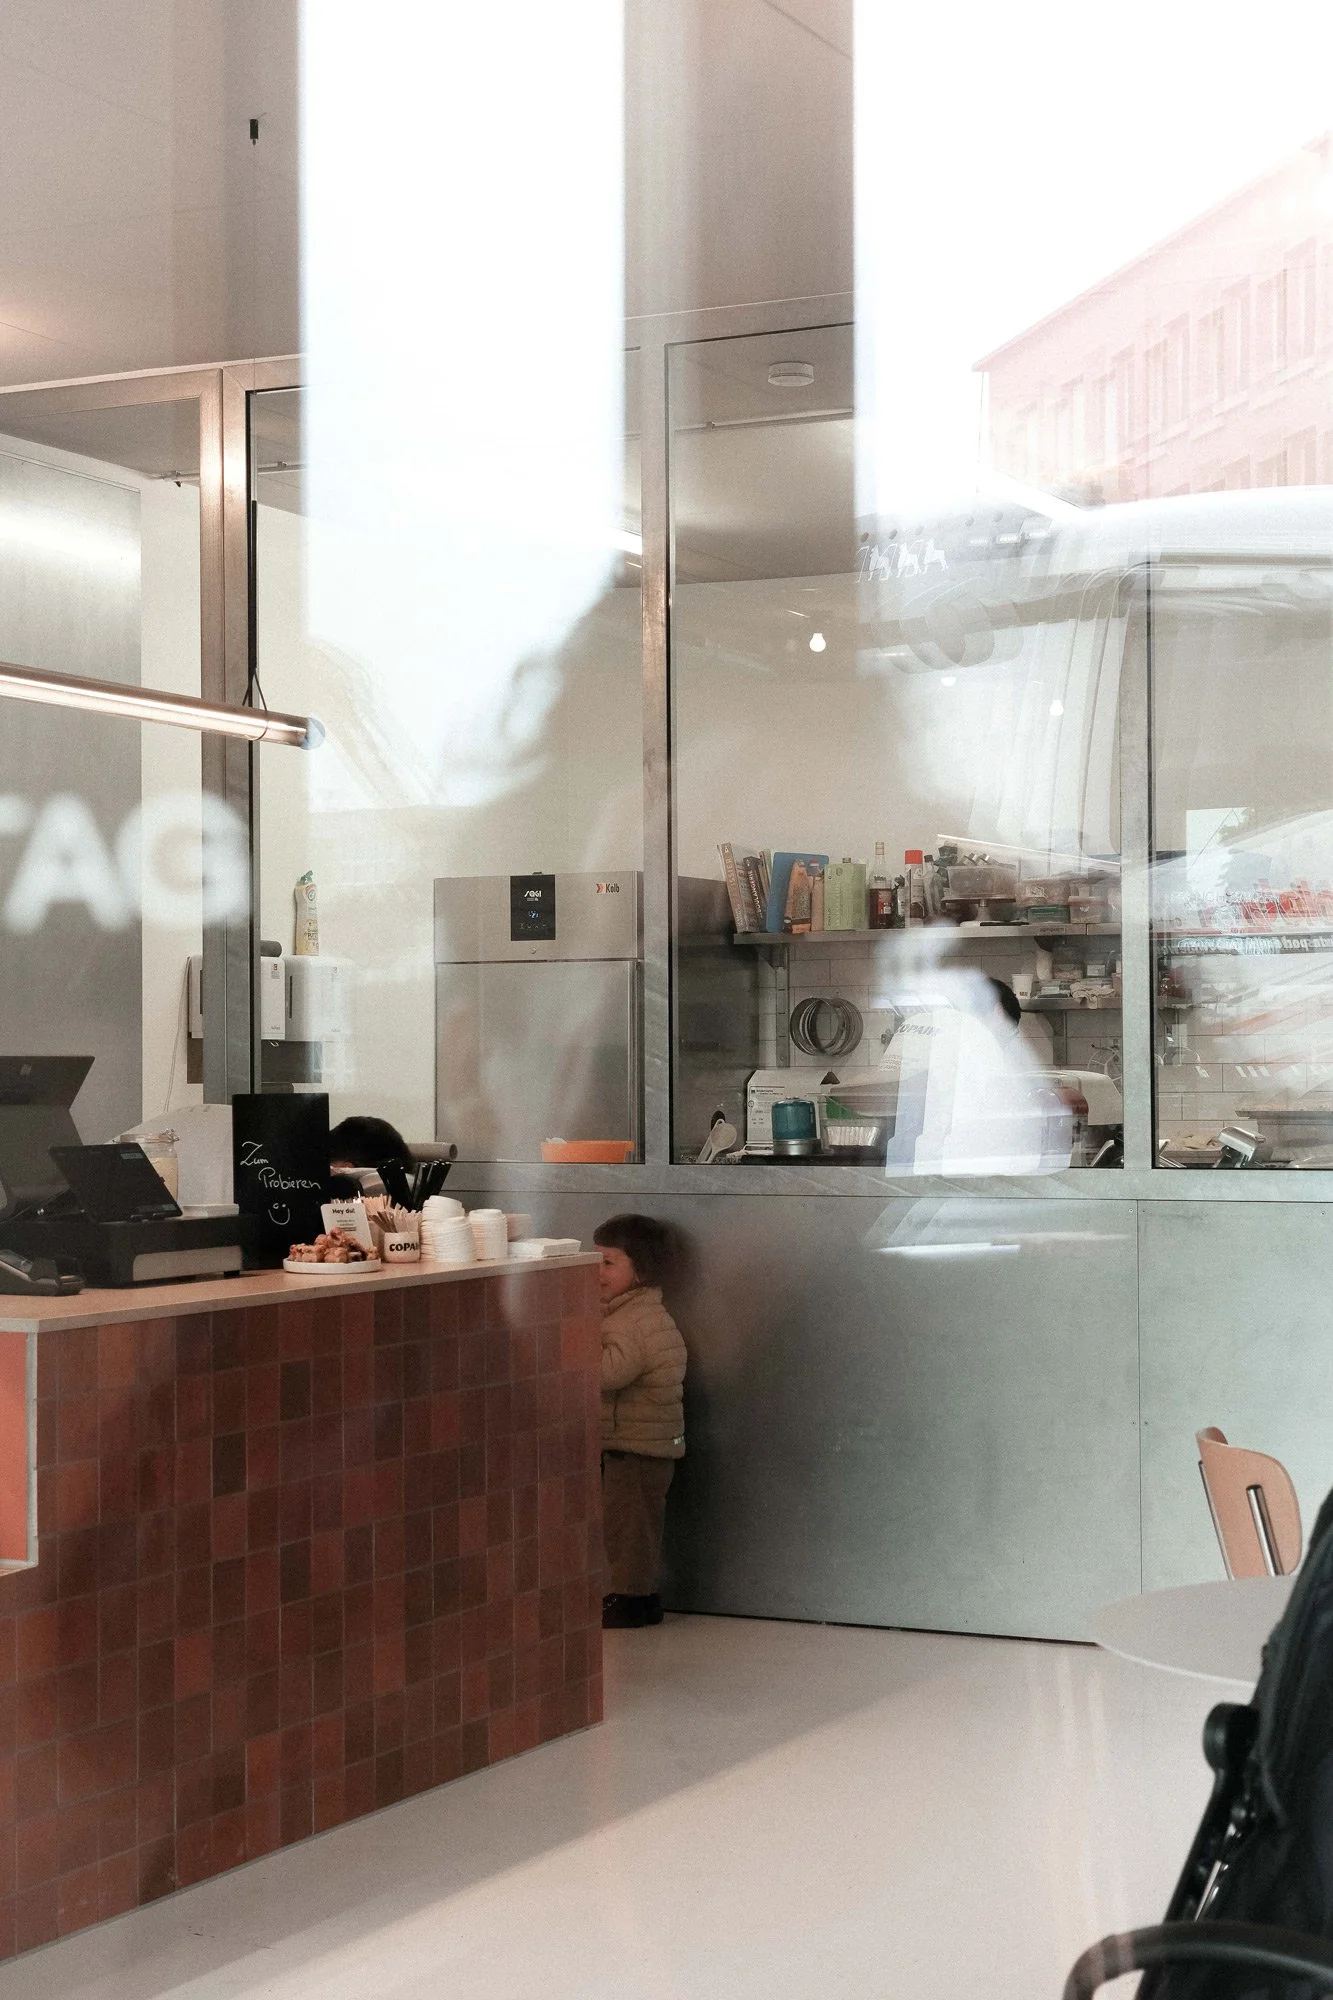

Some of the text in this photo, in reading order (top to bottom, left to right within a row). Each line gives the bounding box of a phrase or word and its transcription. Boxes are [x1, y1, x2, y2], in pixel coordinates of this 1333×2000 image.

[605, 883, 620, 893] Kolb
[748, 869, 762, 913] BOULANGERIE
[240, 1141, 269, 1166] Zum
[258, 1166, 321, 1190] Probieren
